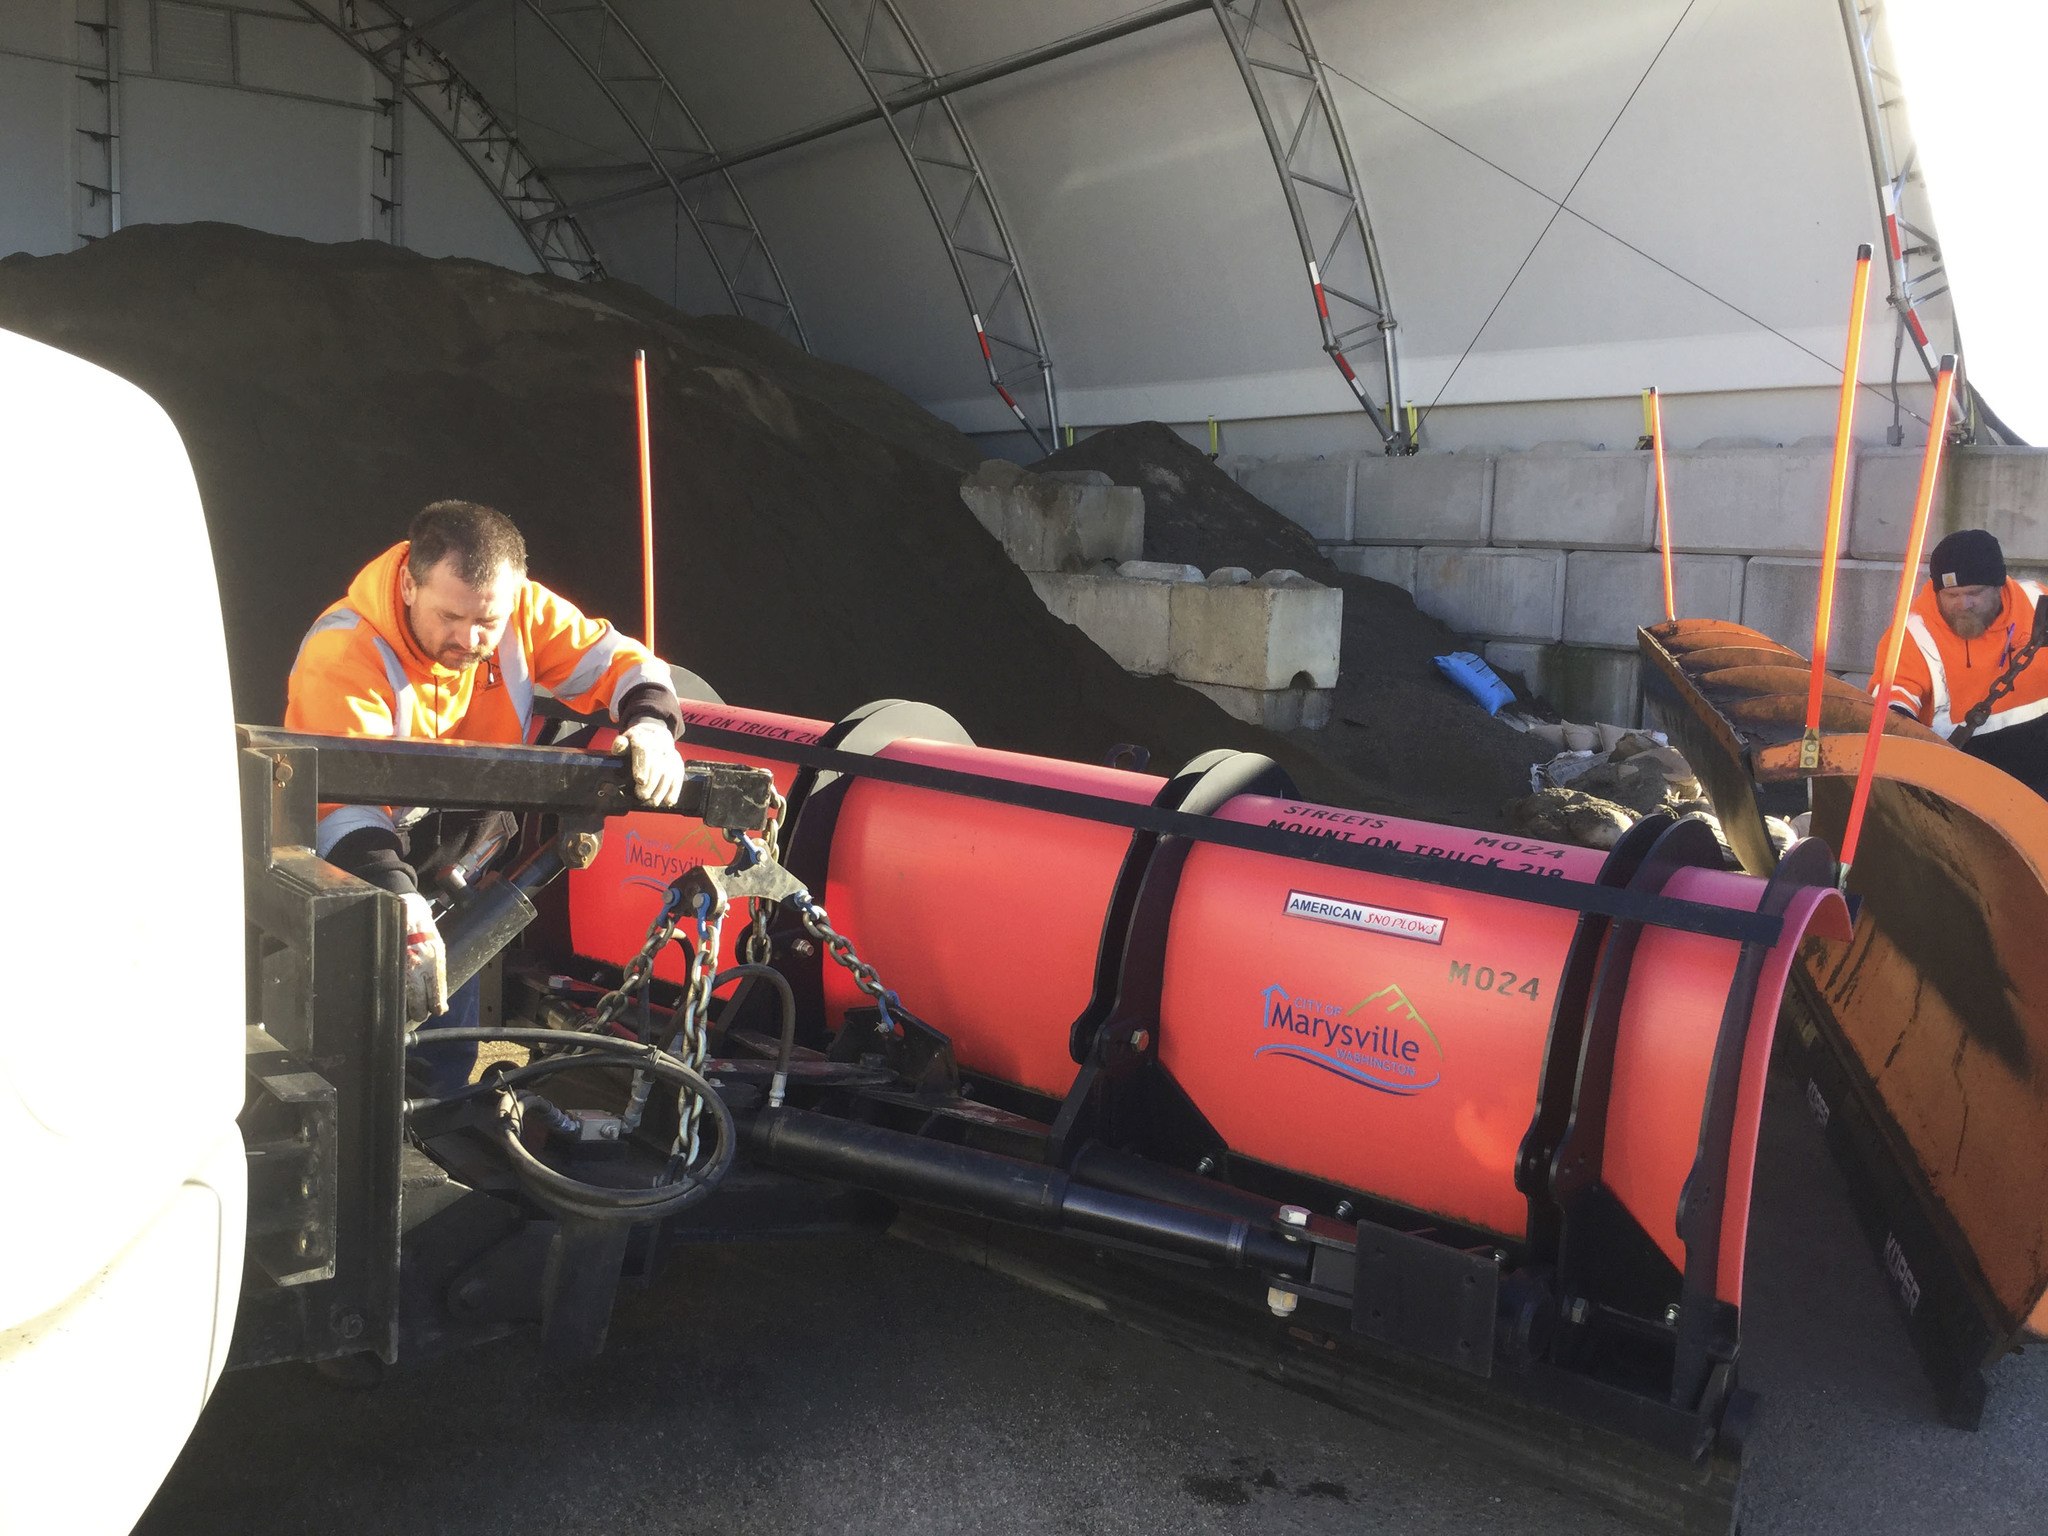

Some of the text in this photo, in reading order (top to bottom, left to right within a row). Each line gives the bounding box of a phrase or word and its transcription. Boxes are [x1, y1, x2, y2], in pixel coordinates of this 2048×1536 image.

[709, 716, 735, 729] ON
[736, 721, 795, 740] TRUCK
[1283, 805, 1388, 829] STREETS
[1267, 819, 1356, 842] MOUNT
[1363, 836, 1402, 851] ON
[1414, 844, 1505, 868] TRUCK
[1290, 898, 1438, 935] AMERICAN SNO PLOWS
[1293, 996, 1343, 1016] CITY OF
[1271, 1002, 1420, 1062] Marysville
[1335, 1047, 1417, 1078] WASHINGTON
